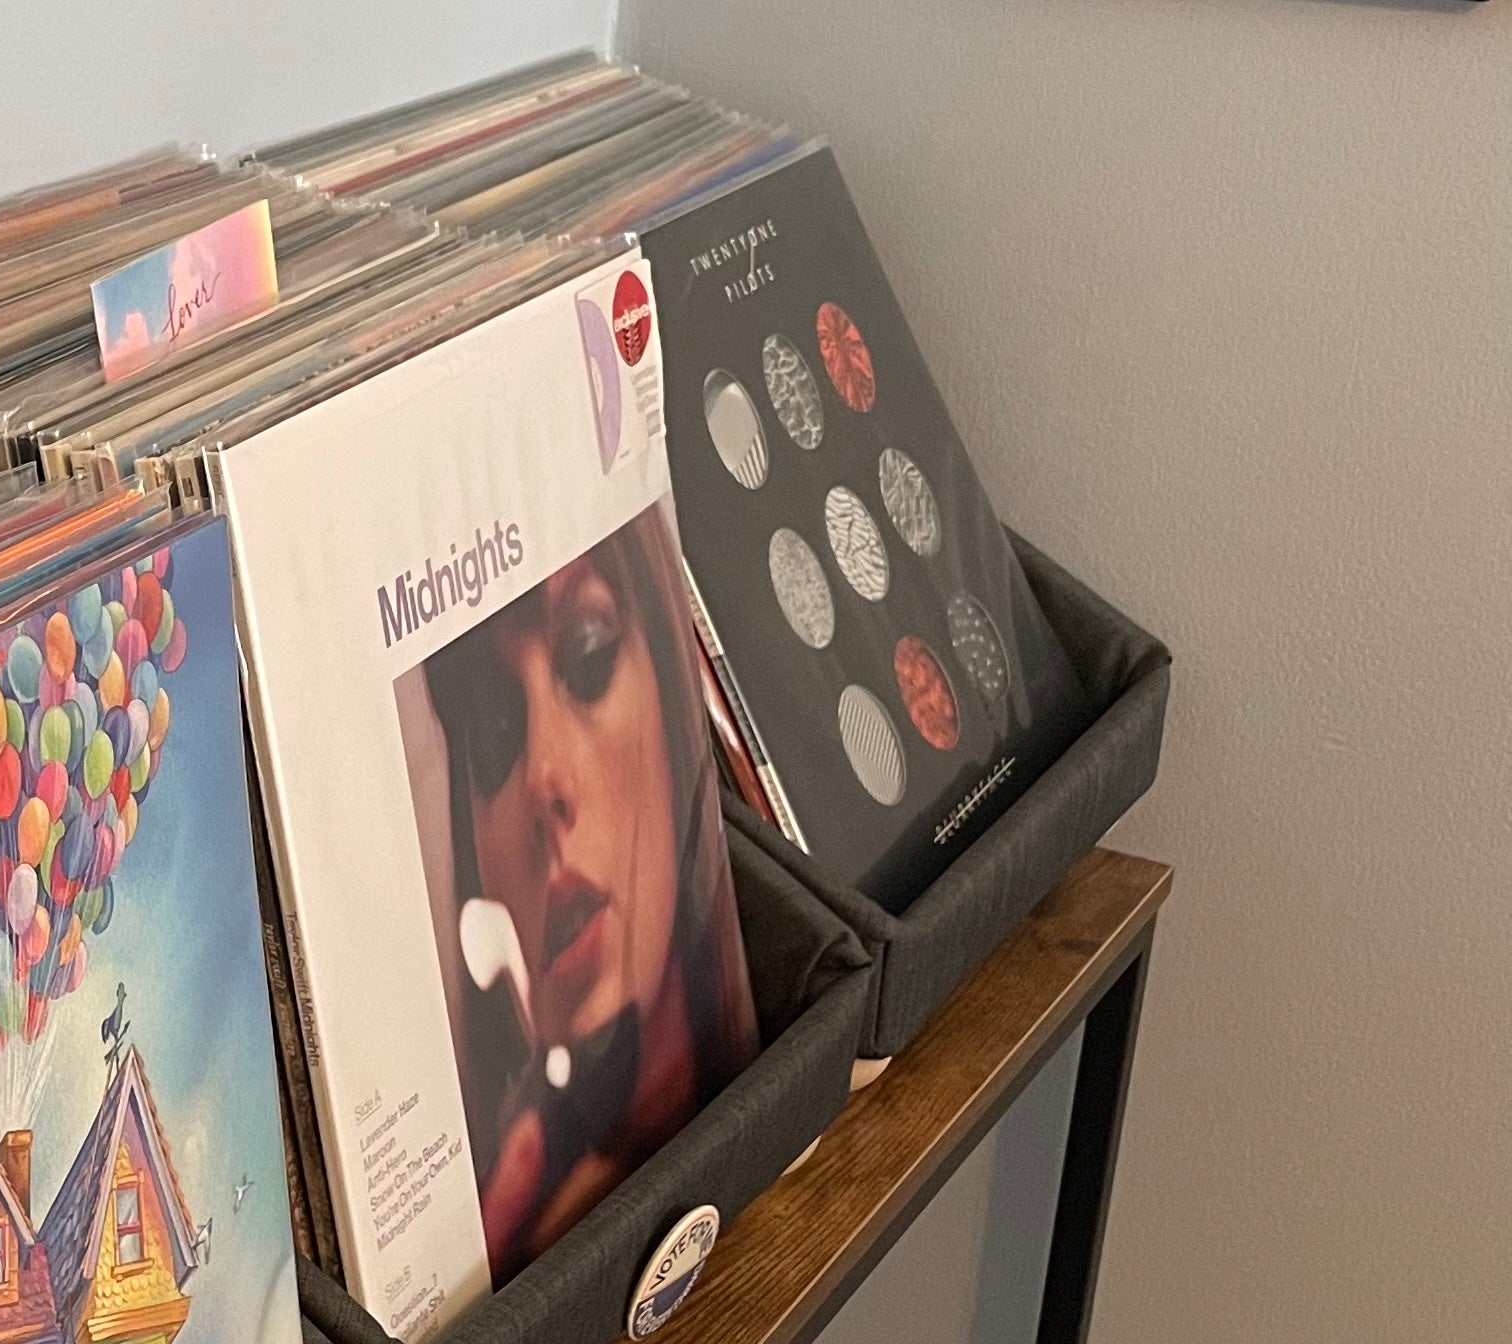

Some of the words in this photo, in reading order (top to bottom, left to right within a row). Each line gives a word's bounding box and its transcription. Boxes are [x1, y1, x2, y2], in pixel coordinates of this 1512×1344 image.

[377, 520, 524, 649] Midnights
[284, 910, 305, 955] Taylor
[290, 954, 311, 995] Swift
[295, 996, 326, 1067] Midnights
